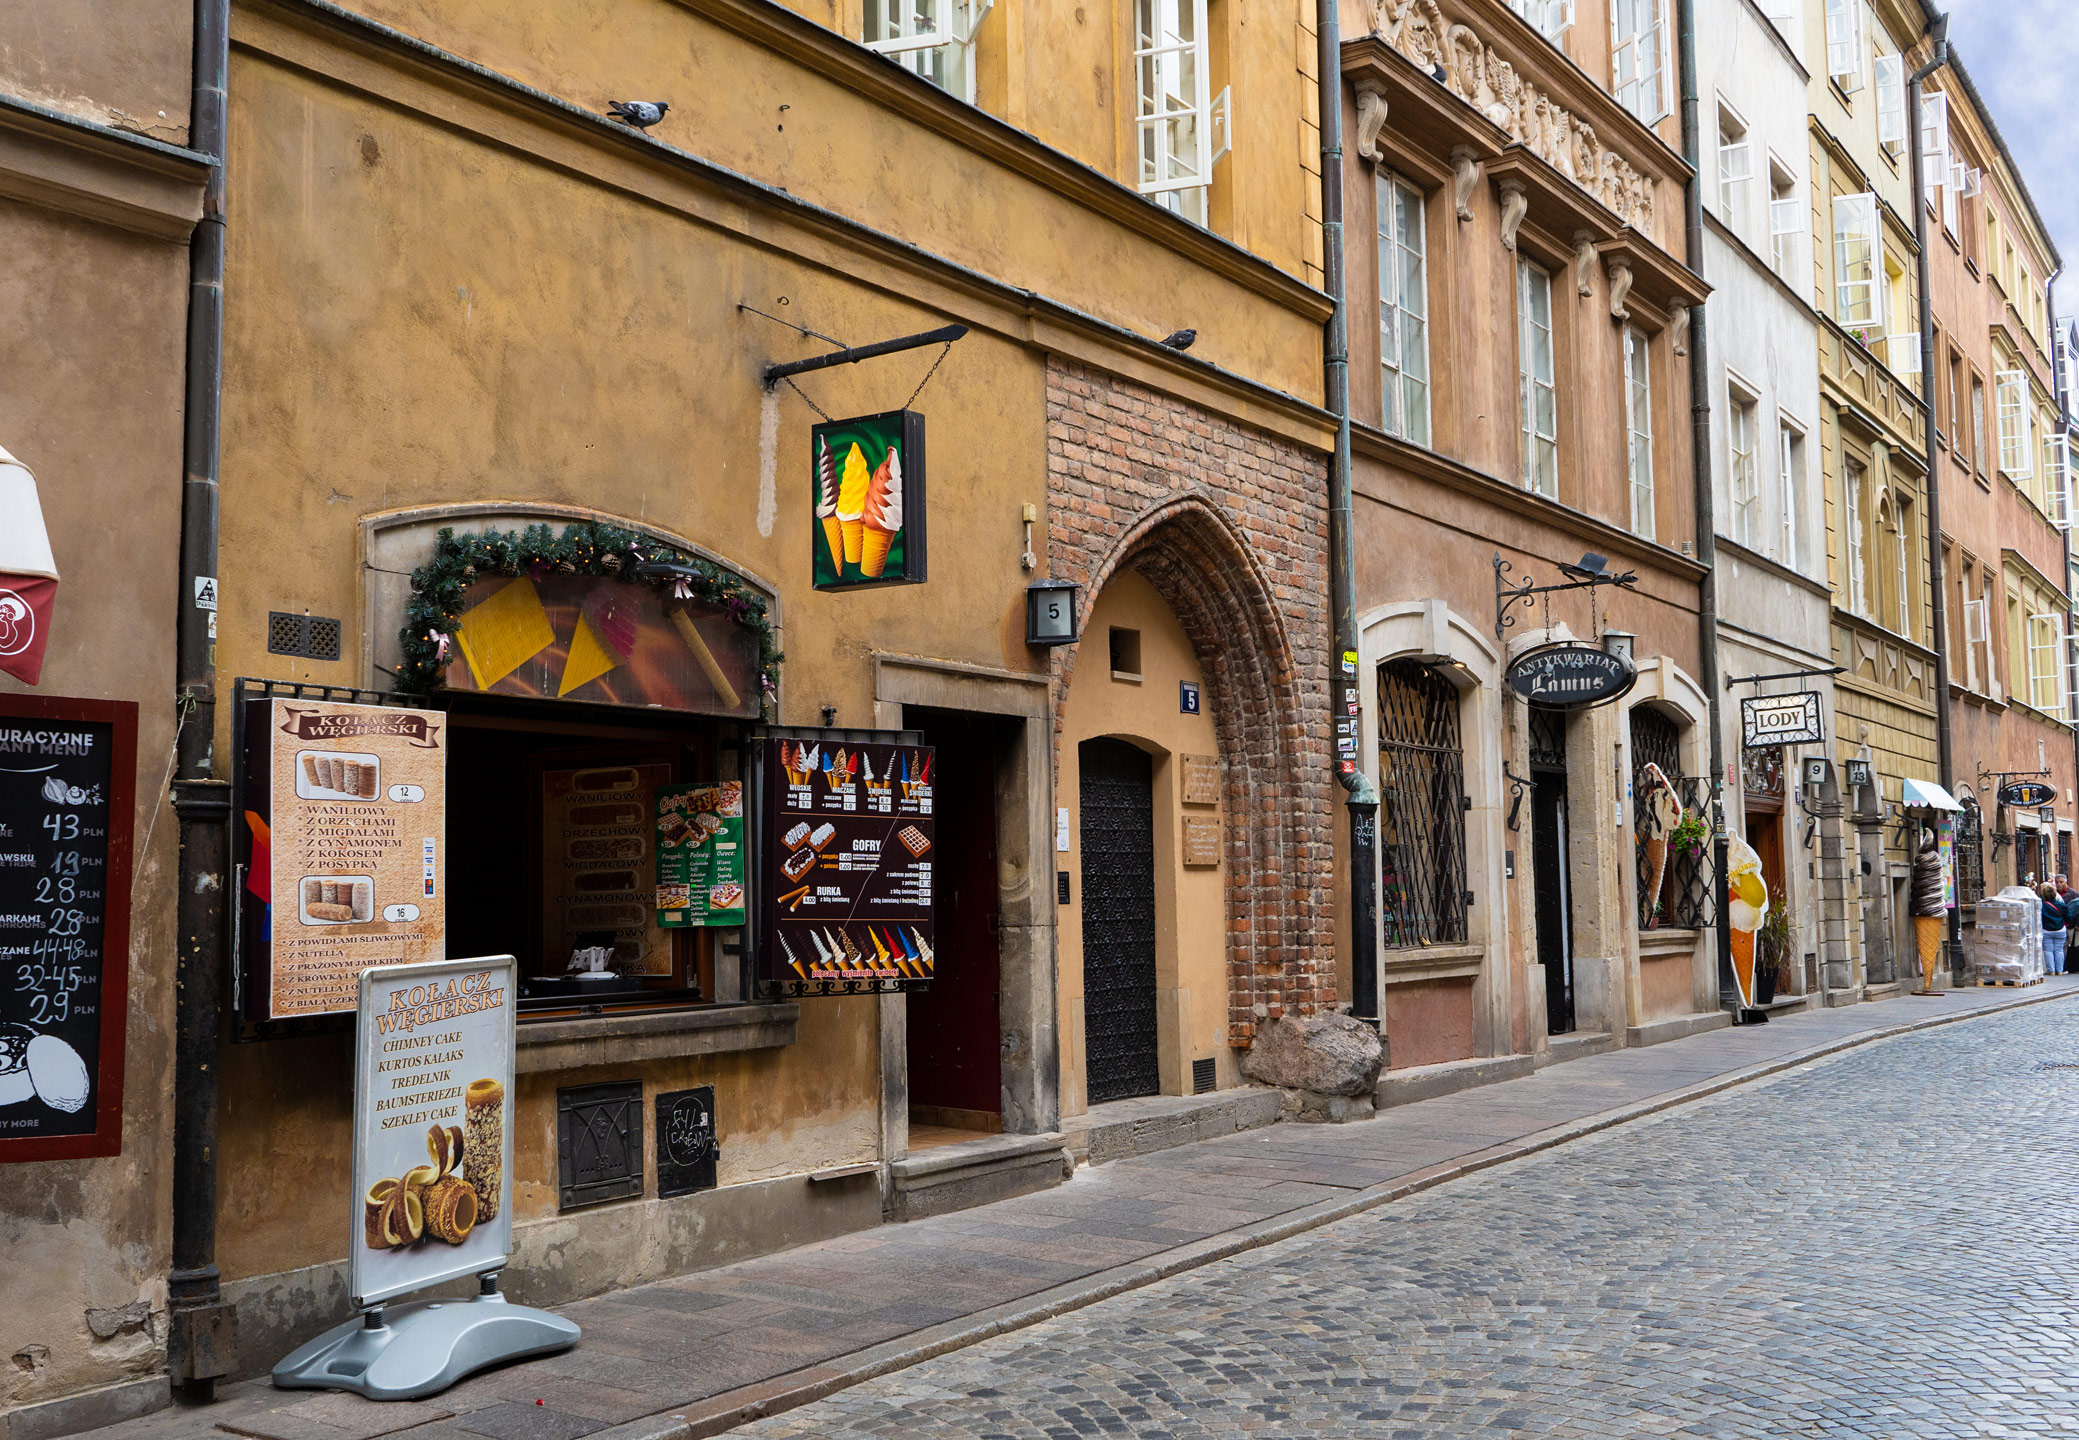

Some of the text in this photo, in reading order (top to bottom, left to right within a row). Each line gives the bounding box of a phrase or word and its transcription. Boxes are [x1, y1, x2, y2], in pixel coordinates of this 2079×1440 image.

[1049, 603, 1060, 619] 5
[1616, 645, 1625, 655] 7
[1517, 653, 1620, 678] ANTYKWARIAT
[1530, 674, 1604, 696] Lamus
[1188, 691, 1195, 710] 5
[320, 714, 407, 726] KOŁACZ
[1759, 711, 1801, 728] LODY
[308, 724, 418, 738] WĘGIERSKI
[40, 743, 89, 757] MENU
[1812, 765, 1821, 775] 9
[1853, 771, 1865, 782] 13
[400, 787, 409, 797] 12
[566, 791, 643, 803] WANILIOWY
[306, 806, 388, 815] WANILIOWY
[660, 793, 688, 815] Gofry
[43, 814, 104, 841] 43 PLN
[306, 817, 396, 826] Z ORZECHAMI
[306, 828, 395, 837] Z MIGDAŁAMI
[562, 826, 649, 838] ORZECHOWY
[306, 838, 402, 848] Z CYNAMONEM
[852, 839, 881, 852] GOFRY
[306, 849, 382, 858] Z KOKOSEM
[50, 851, 102, 876] 19 PLN
[306, 860, 378, 871] Z POSYPKĄ
[564, 859, 648, 869] MIGDAŁOWY
[34, 877, 100, 903] 28 PLN
[817, 886, 841, 896] RURKA
[556, 893, 657, 904] CYNAMONOWY
[397, 908, 405, 918] 16
[48, 908, 99, 935] 28 PLN
[288, 933, 423, 947] Z POWIDŁAMI ŚLIWKOWYMI
[566, 929, 647, 938] KOWY
[288, 950, 344, 959] Z NUTELLĄ
[288, 957, 403, 971] Z PRAŻONYM JABŁKIEM
[14, 964, 82, 992] 32-45
[288, 975, 295, 983] Z
[297, 973, 343, 983] KRÓWKĄ
[296, 986, 343, 995] NUTELLĄ
[388, 971, 492, 1013] KOŁACZ
[29, 991, 95, 1025] 29 PLN
[296, 999, 327, 1008] BIAŁĄ
[376, 987, 504, 1036] WĘGIERSKI
[383, 1031, 463, 1053] CHIMNEY CAKE
[378, 1049, 464, 1073] KURTOS KALAKS
[391, 1069, 452, 1090] TREDELNIK
[376, 1086, 463, 1112] BAUMSTERIEZEL
[11, 1119, 40, 1128] MORE
[381, 1105, 458, 1130] SZEKLEY CAKE
